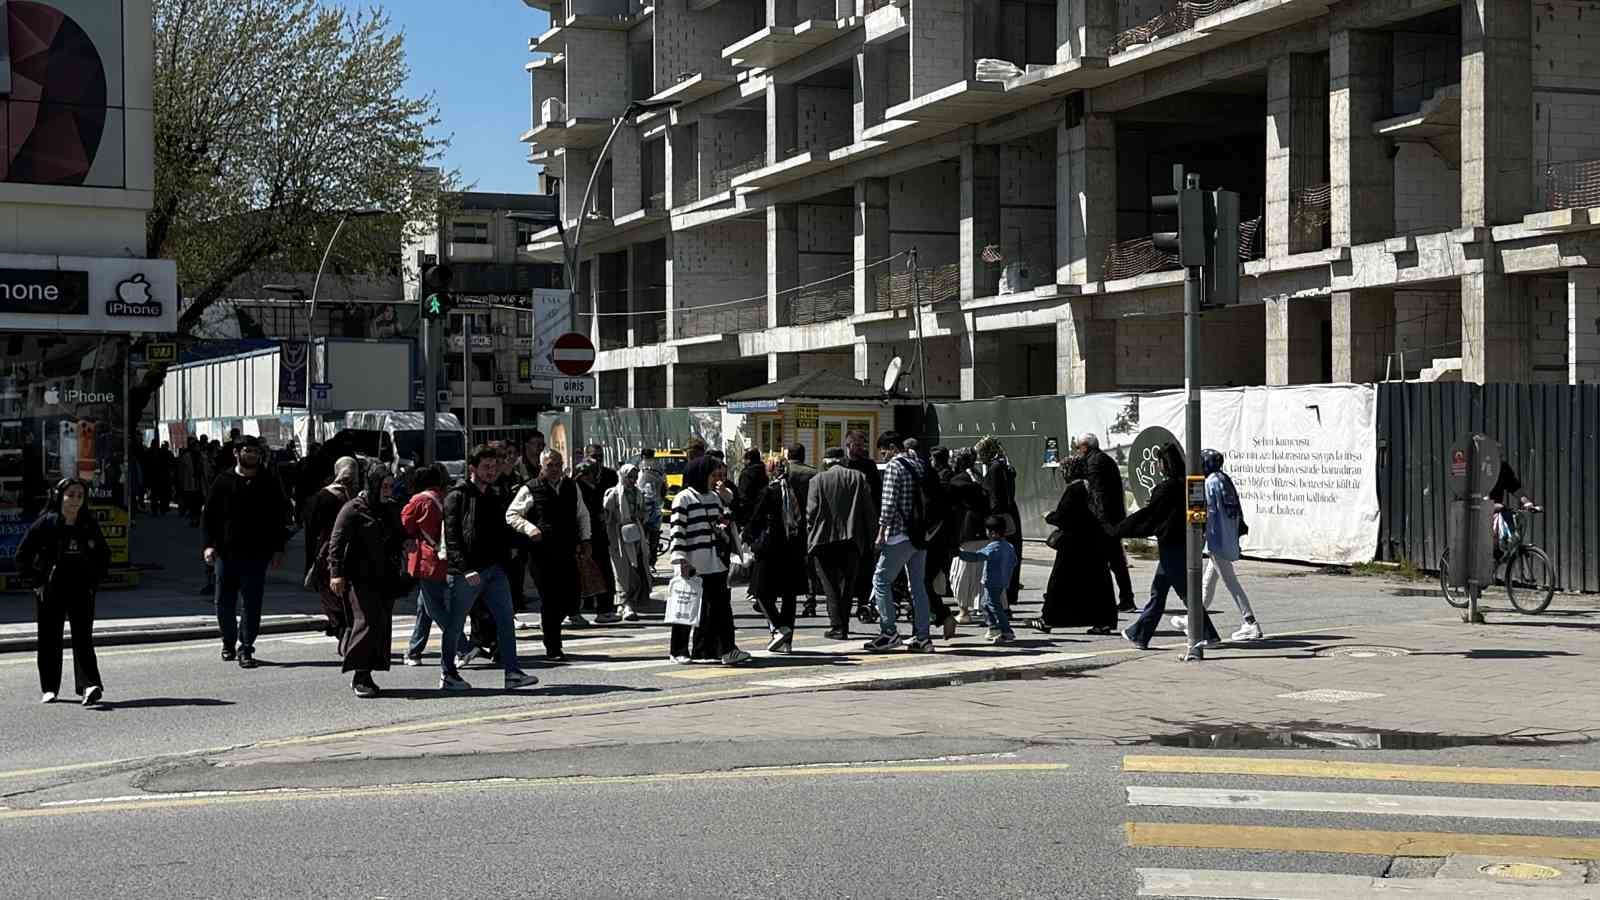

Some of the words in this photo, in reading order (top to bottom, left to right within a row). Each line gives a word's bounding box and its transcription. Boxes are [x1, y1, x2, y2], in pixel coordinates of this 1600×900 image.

[109, 302, 160, 316] iPhone
[563, 379, 585, 393] GİRİŞ
[64, 390, 115, 404] iPhone
[555, 394, 593, 405] YASAKTIR
[88, 487, 113, 498] Max
